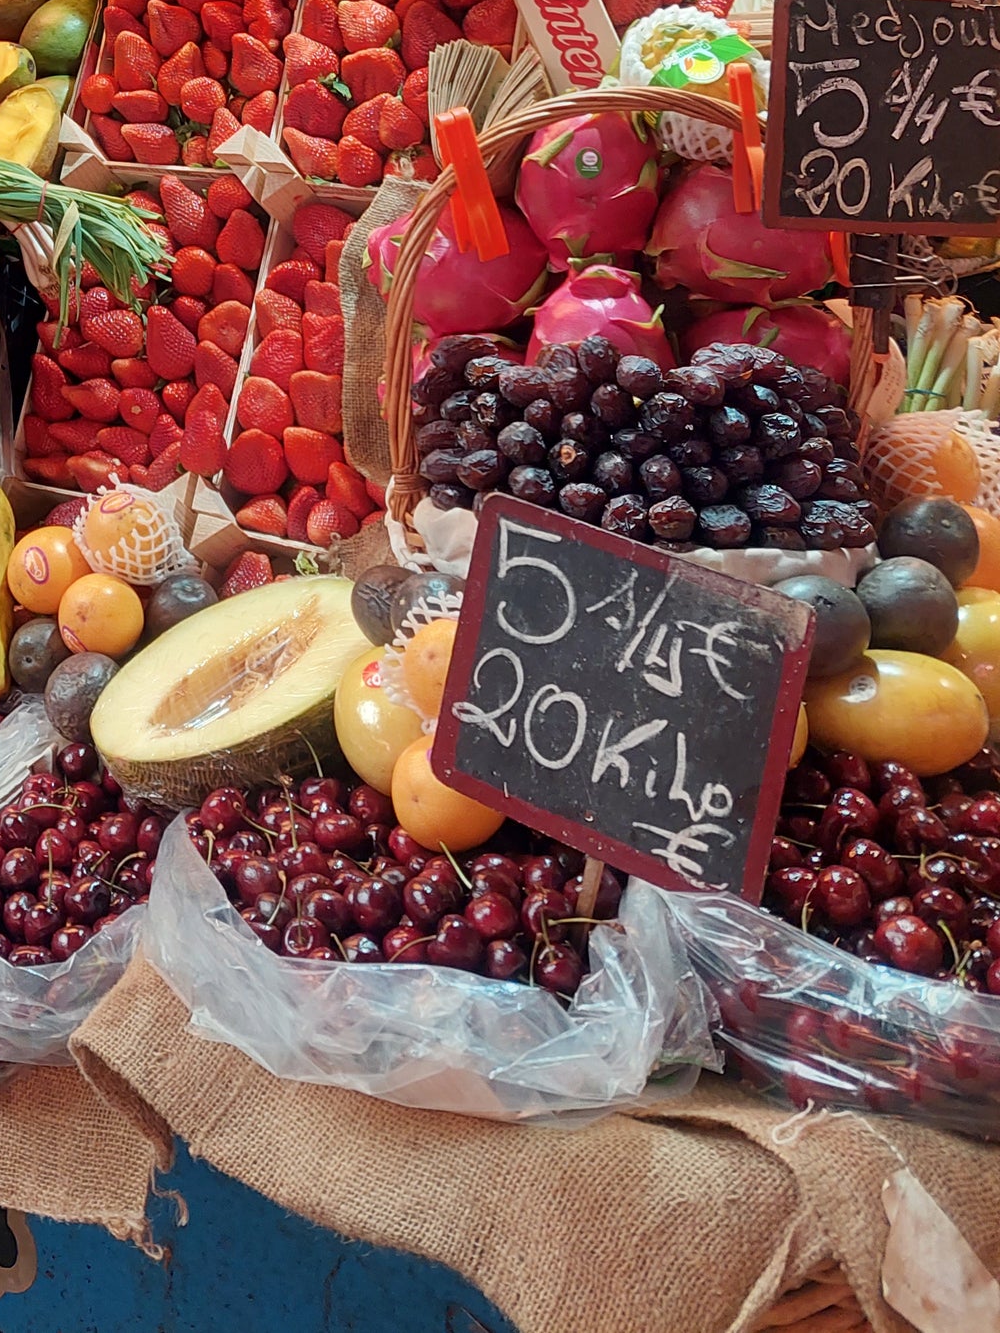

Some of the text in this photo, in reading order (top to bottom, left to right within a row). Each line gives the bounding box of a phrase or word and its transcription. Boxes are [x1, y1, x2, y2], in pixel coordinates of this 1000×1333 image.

[788, 57, 870, 149] 5
[795, 148, 871, 216] 20
[496, 517, 578, 646] 5
[451, 647, 588, 771] 20
